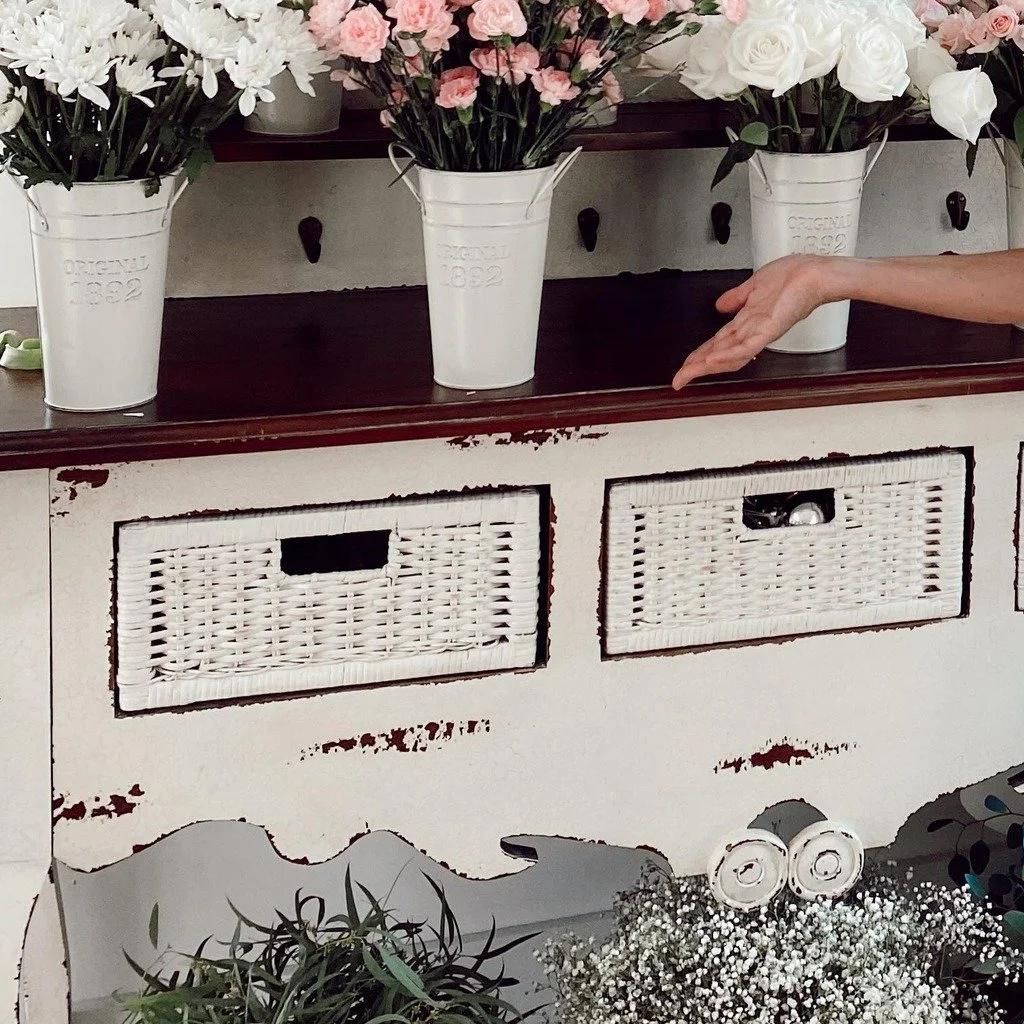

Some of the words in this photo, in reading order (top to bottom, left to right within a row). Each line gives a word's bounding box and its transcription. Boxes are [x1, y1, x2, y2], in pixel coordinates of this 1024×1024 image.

[787, 214, 853, 231] ORIGINAL
[436, 243, 512, 261] ORIGINAL
[792, 233, 847, 255] 1892
[63, 255, 150, 275] ORIGINAL
[440, 265, 504, 288] 1892
[70, 277, 143, 305] 1892
